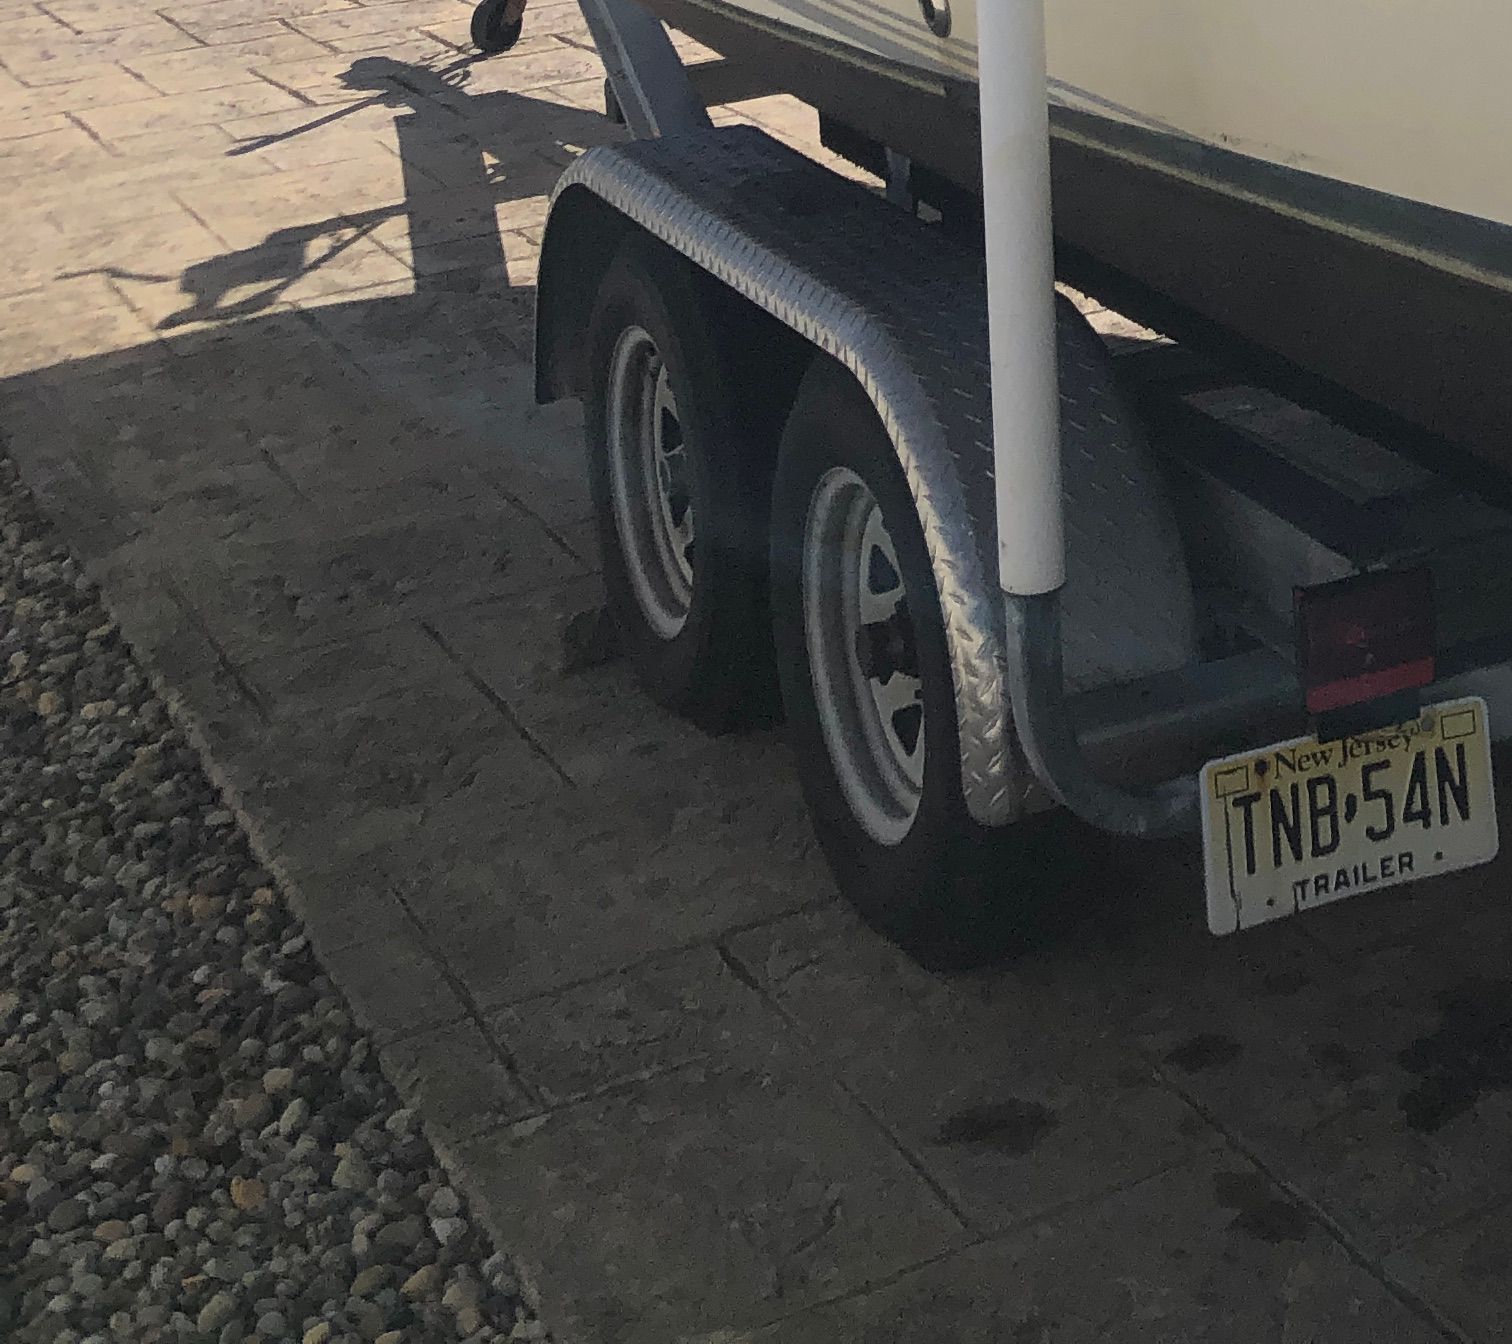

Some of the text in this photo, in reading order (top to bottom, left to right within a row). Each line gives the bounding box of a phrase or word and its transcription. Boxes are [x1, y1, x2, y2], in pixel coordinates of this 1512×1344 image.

[1273, 729, 1413, 780] New Jersey
[1295, 851, 1415, 902] TRAILER
